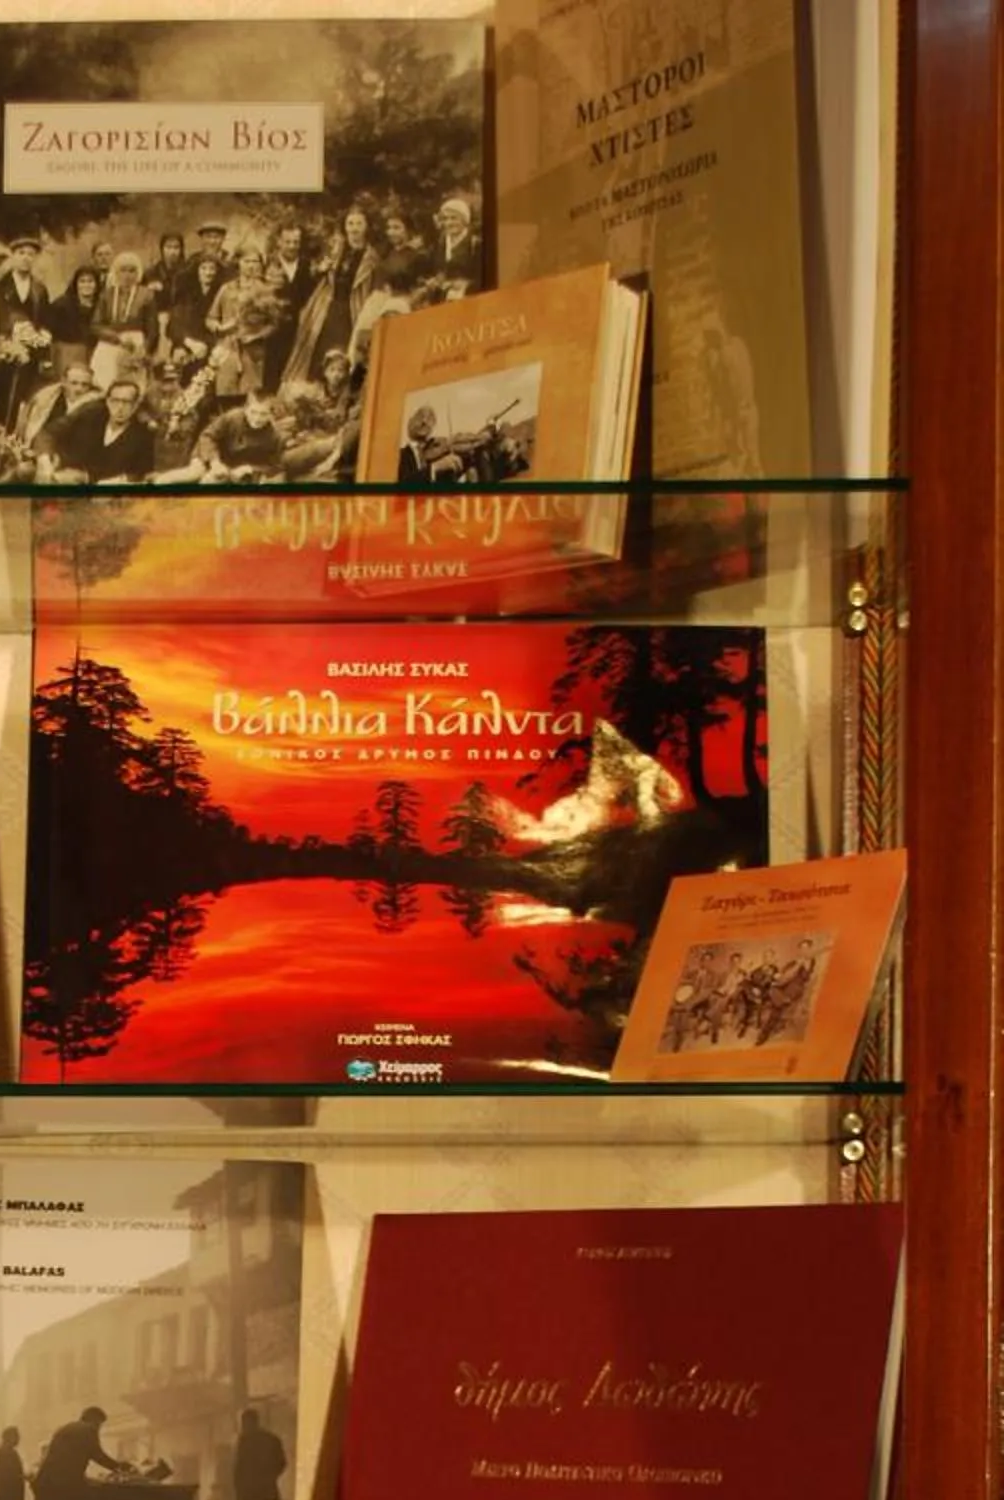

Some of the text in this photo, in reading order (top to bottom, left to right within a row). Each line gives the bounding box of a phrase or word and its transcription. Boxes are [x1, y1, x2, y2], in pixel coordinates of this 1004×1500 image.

[575, 52, 707, 129] ΜΑΣΤΟΡΟΙ
[588, 104, 694, 168] ΧΤΙΣΤΕΣ
[327, 663, 469, 678] ΒΑΣΙΛΗΣ ΣΥΚΑΣ
[405, 690, 583, 737] Κάλντα
[357, 748, 454, 761] ΔΡΥΜΟΣ
[337, 1034, 393, 1046] ΓΙΩΡΓΟΣ
[6, 1201, 85, 1213] ΜΠΑΛΑΦΑΣ
[3, 1265, 65, 1277] BALAFAS
